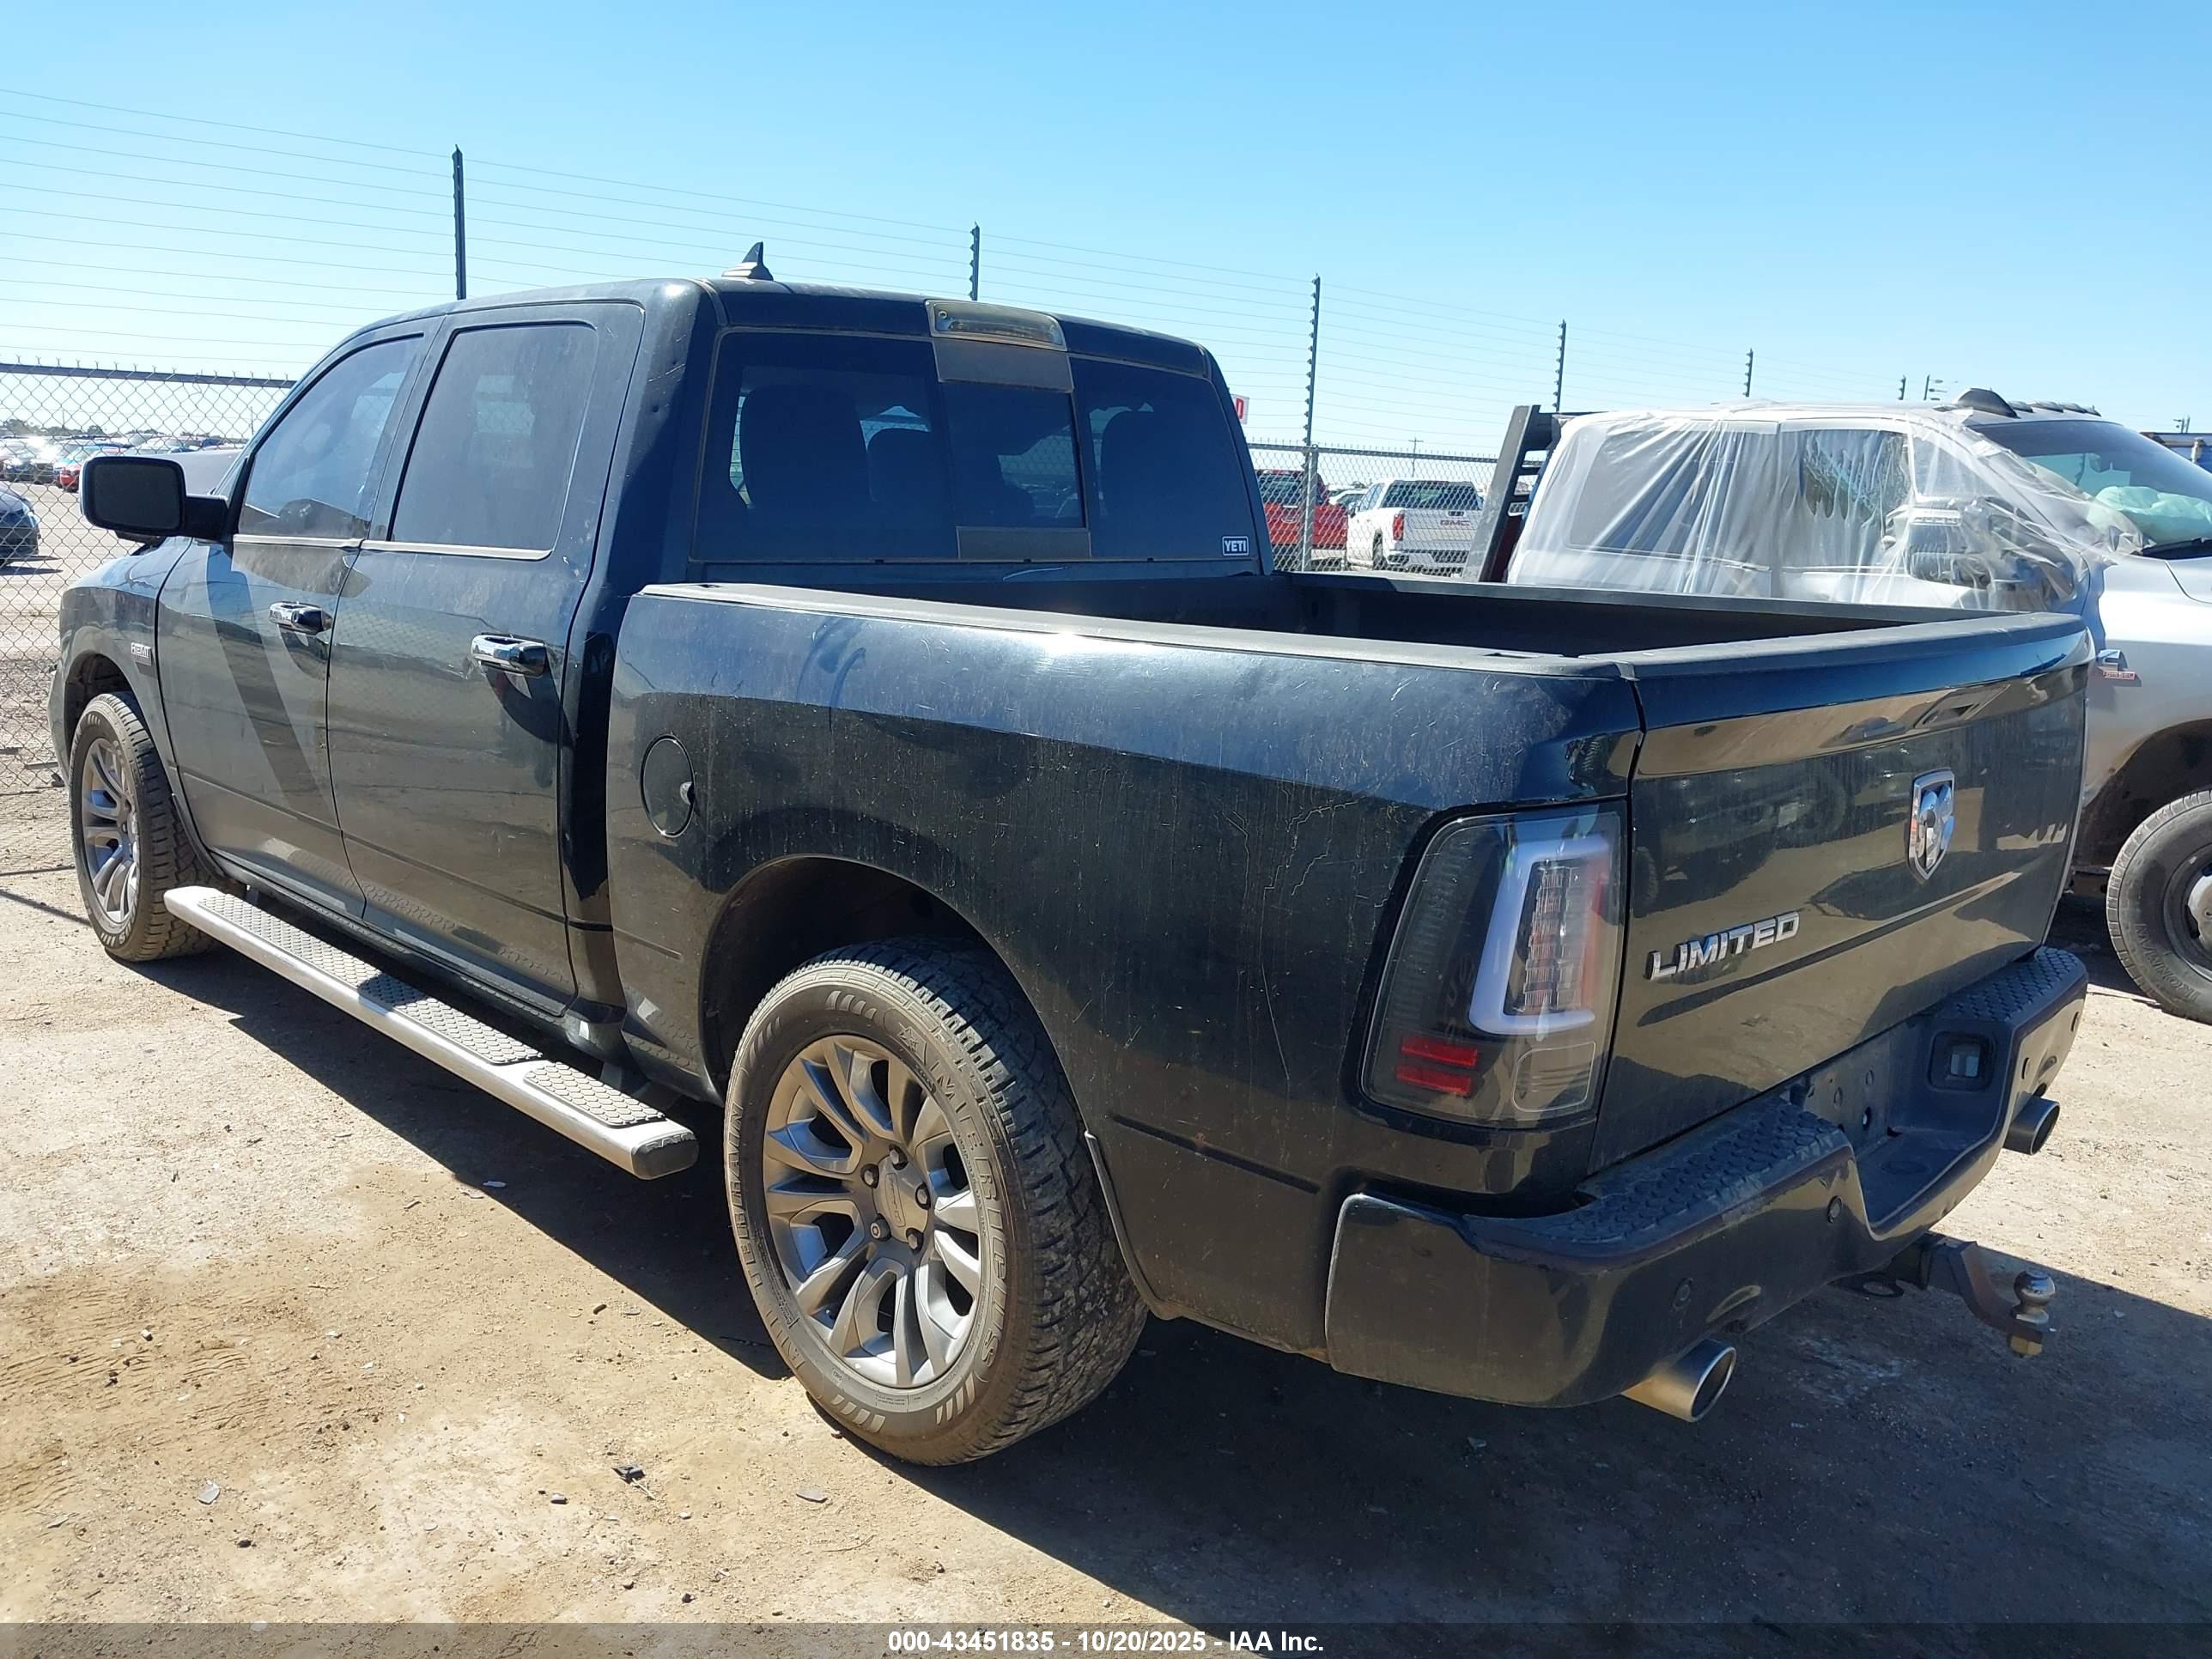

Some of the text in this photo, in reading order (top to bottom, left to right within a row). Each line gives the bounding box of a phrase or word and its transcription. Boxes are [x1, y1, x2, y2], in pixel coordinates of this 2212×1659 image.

[1224, 540, 1247, 552] YETI
[1644, 911, 1801, 981] LIMITED
[727, 1101, 763, 1295] TERRAIN
[897, 1020, 1007, 1367] AMERICUS
